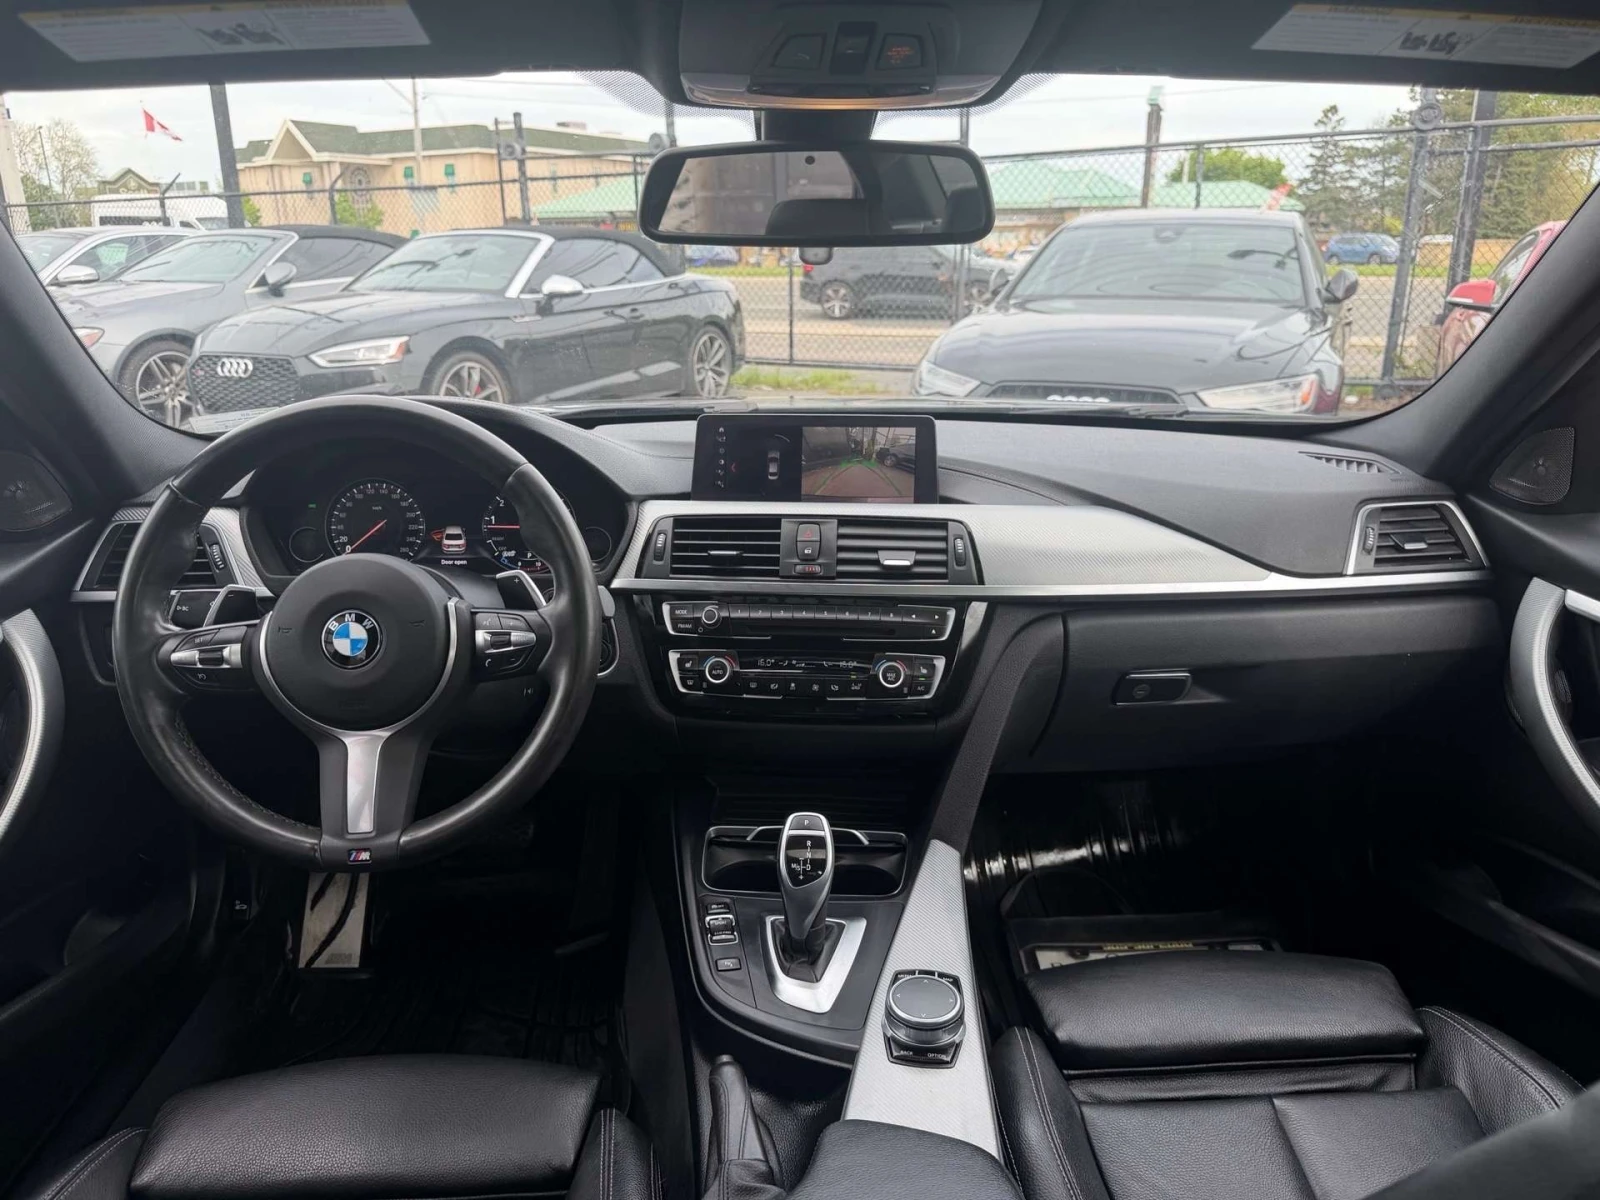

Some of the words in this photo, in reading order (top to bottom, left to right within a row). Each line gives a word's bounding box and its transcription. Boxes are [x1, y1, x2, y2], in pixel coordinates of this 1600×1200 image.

[490, 516, 495, 524] 1
[345, 545, 352, 553] 0
[328, 613, 374, 631] BMW
[806, 851, 812, 859] N
